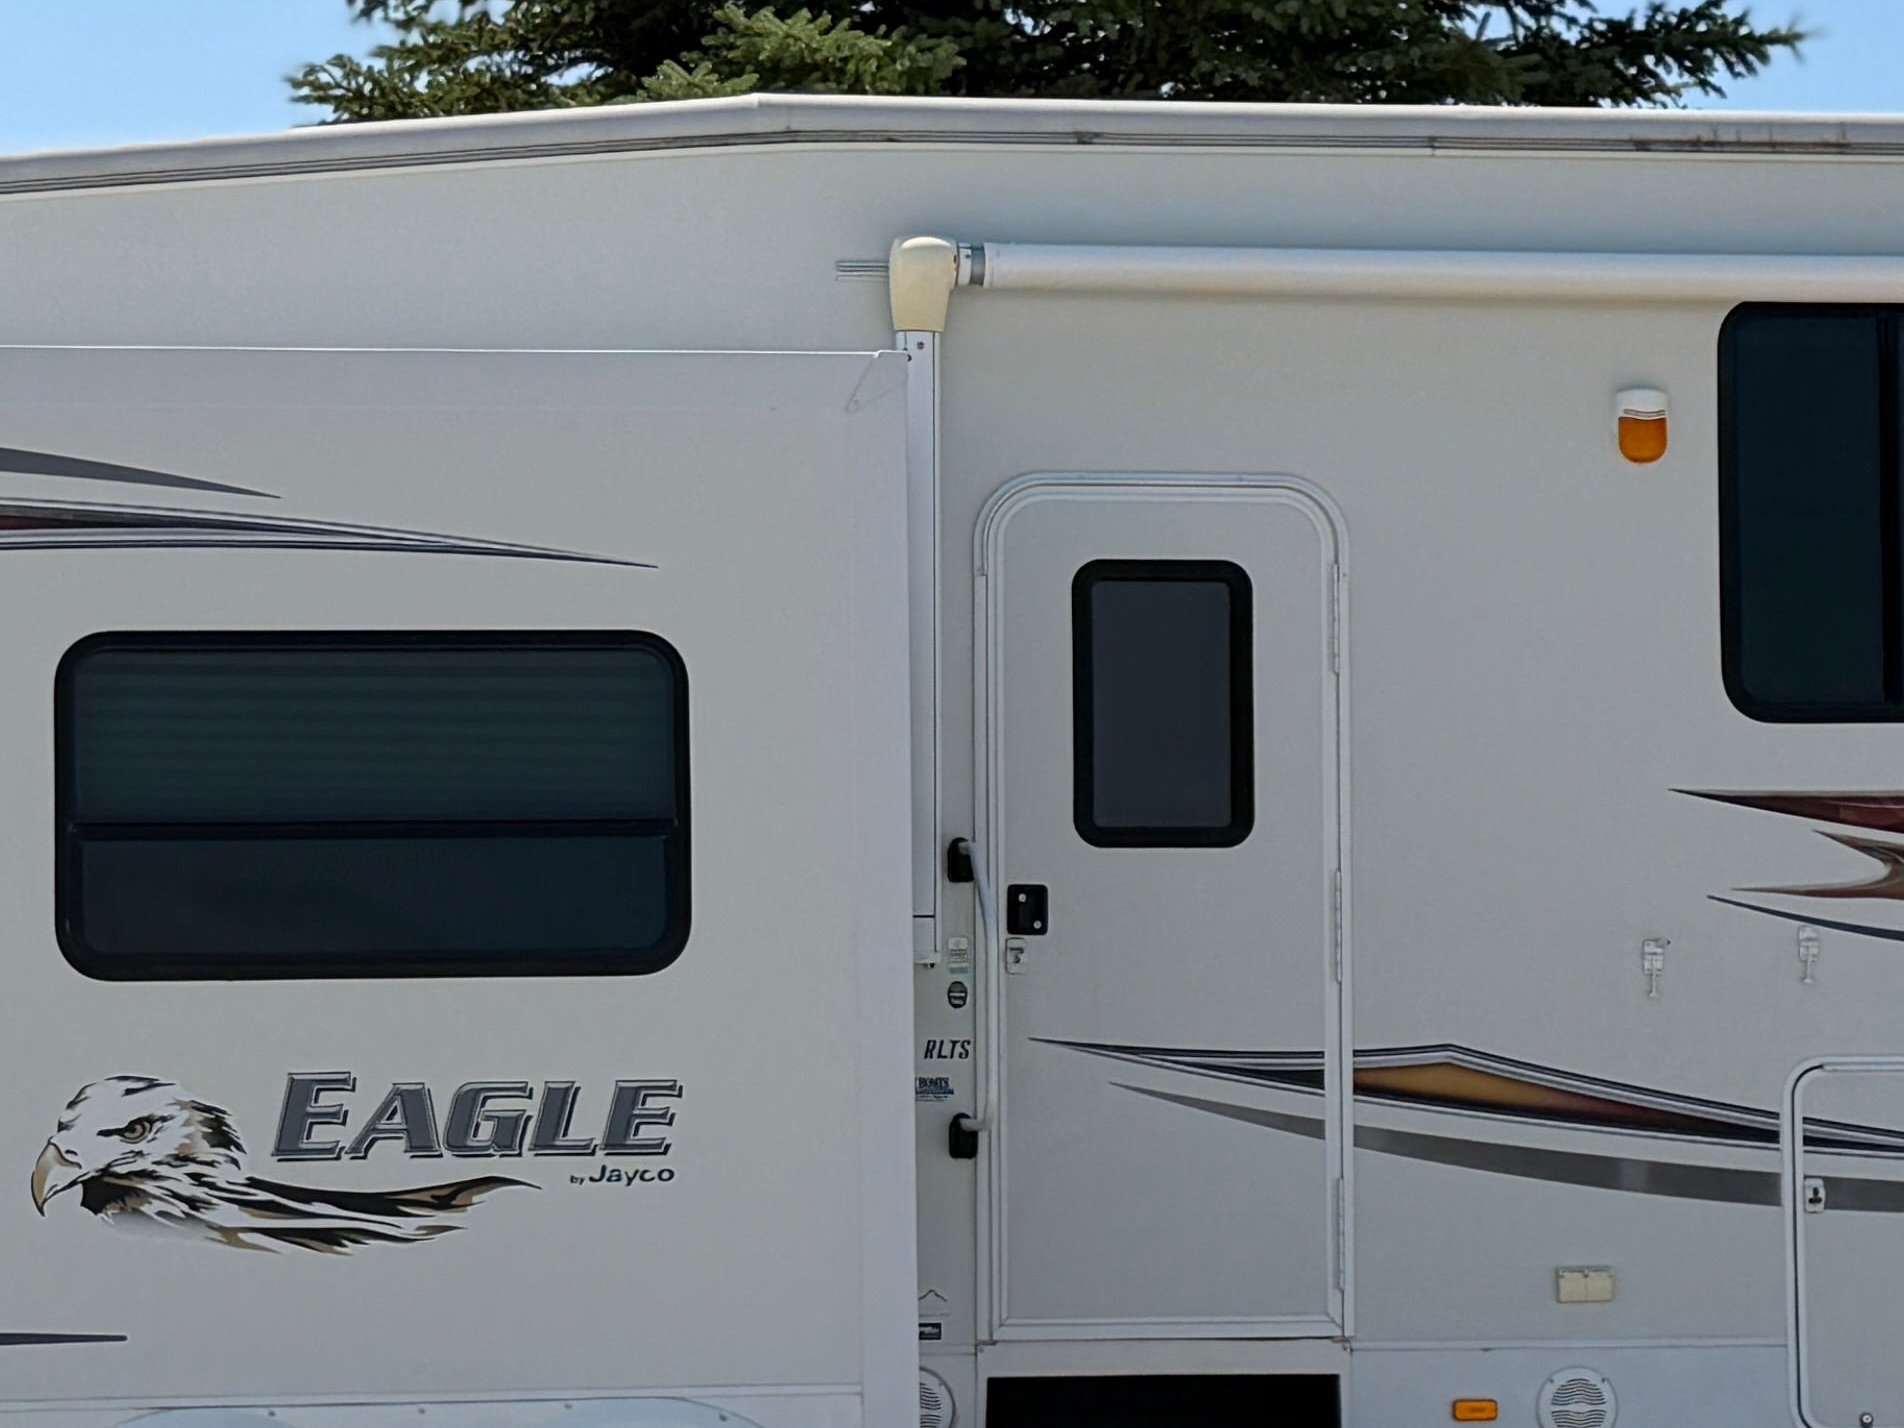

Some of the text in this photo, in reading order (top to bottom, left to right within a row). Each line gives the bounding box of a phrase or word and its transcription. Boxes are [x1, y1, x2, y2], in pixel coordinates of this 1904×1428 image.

[924, 1039, 971, 1060] RLTS
[271, 1071, 683, 1162] EAGLE
[570, 1164, 676, 1187] by Jayco
